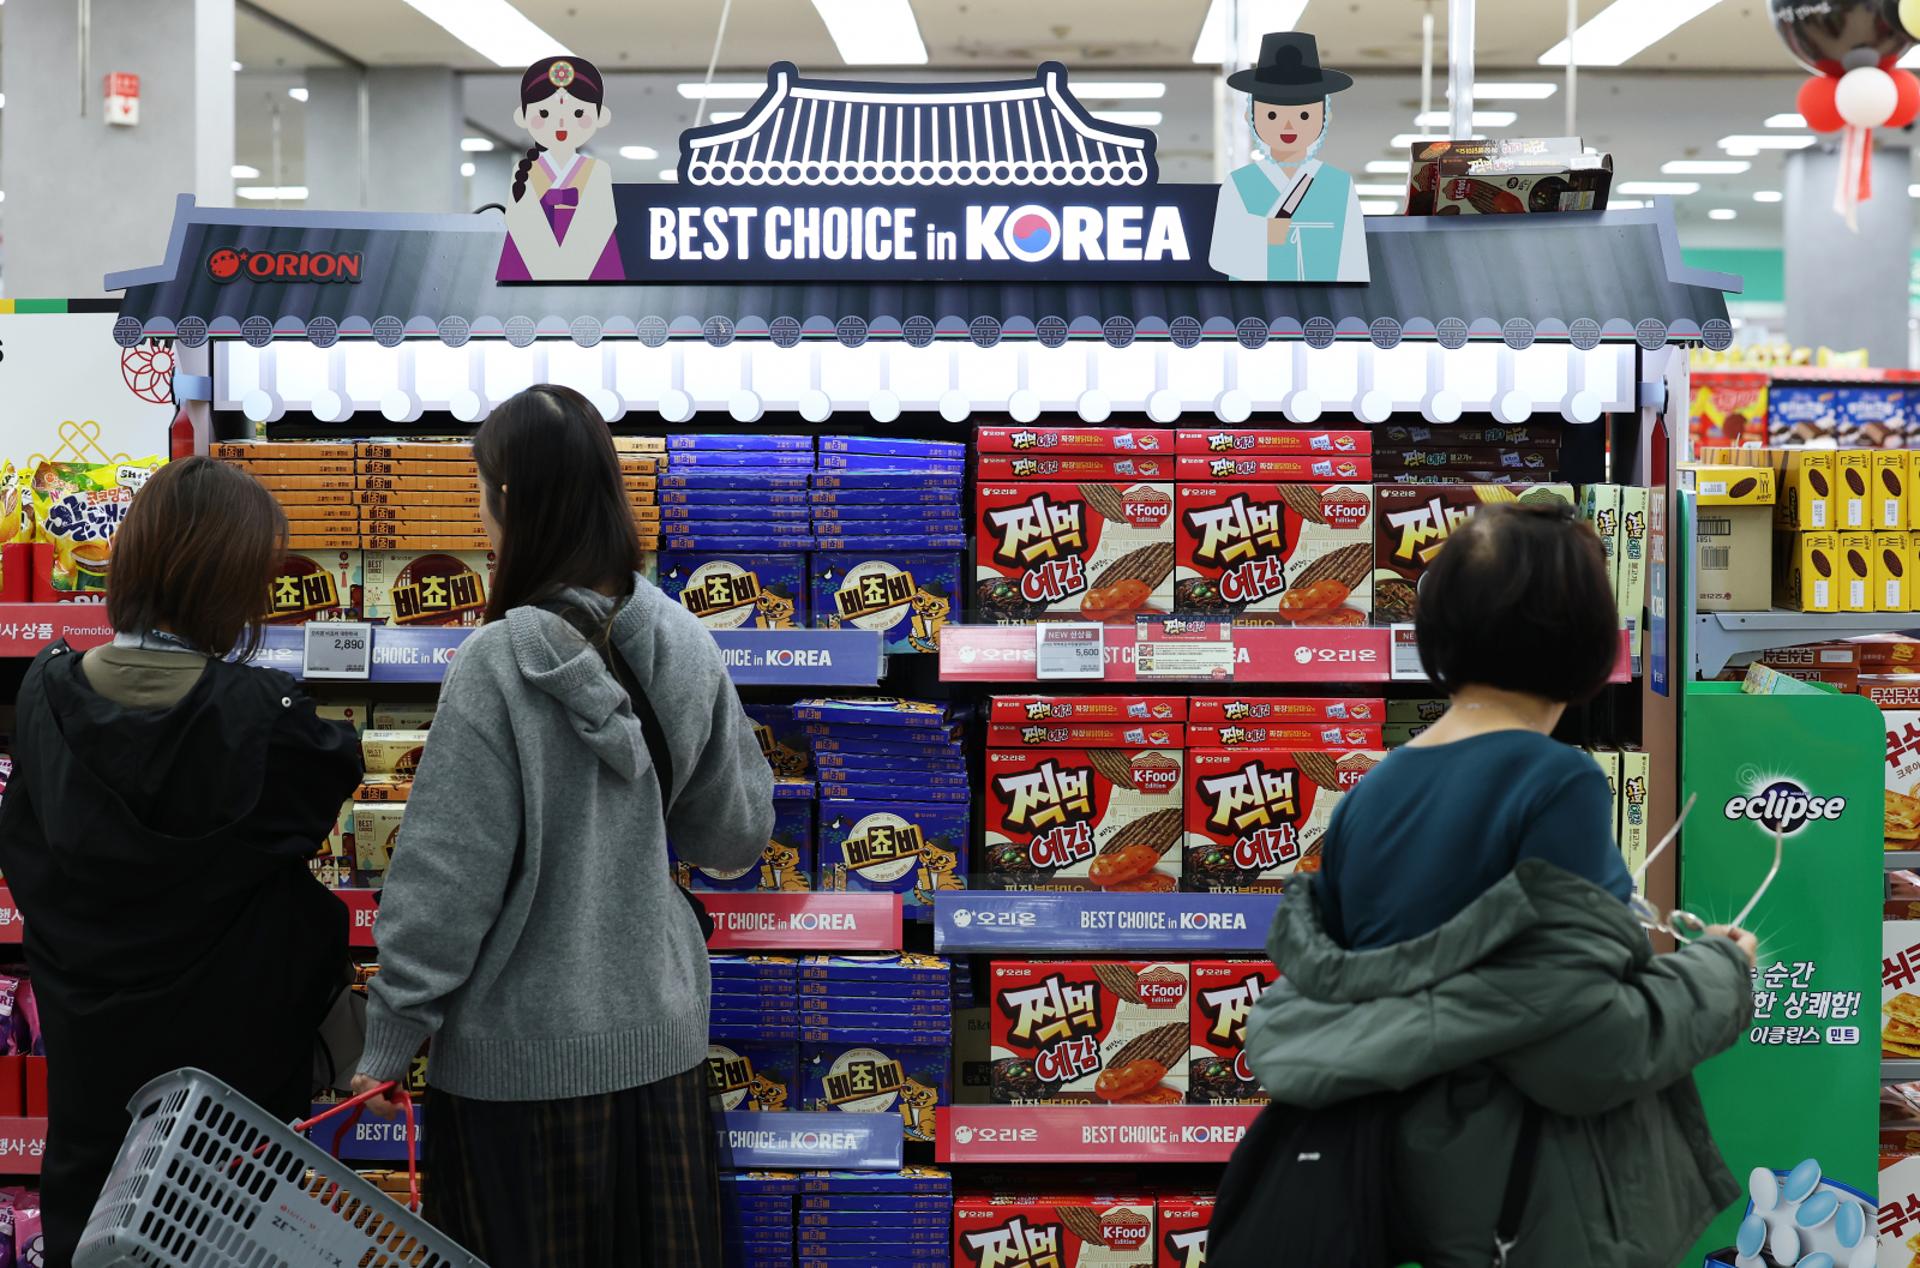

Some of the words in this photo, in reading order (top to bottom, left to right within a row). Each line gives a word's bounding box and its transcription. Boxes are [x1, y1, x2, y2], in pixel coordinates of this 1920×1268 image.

[649, 207, 756, 260] BEST
[764, 206, 917, 261] CHOICE
[927, 224, 956, 260] in
[965, 204, 1191, 263] KOREA
[248, 252, 361, 278] ORION
[1010, 430, 1037, 449] 찍먹
[1037, 433, 1058, 448] 예감
[1207, 432, 1234, 451] 찍먹
[1234, 435, 1255, 449] 예감
[1011, 457, 1038, 477] 찍먹
[1038, 460, 1059, 474] 예감
[1209, 458, 1236, 478] 찍먹
[1236, 460, 1256, 474] 예감
[1402, 450, 1427, 466] 찍먹
[989, 496, 1082, 562] 찍먹
[1188, 496, 1280, 562] 찍먹
[1597, 508, 1618, 537] 찍먹
[1625, 511, 1646, 539] 찍먹
[1626, 538, 1642, 560] 예감
[1021, 559, 1086, 603] 예감
[1219, 559, 1285, 603] 예감
[268, 574, 330, 615] 쵸비
[393, 574, 481, 618] 비쵸비
[684, 573, 757, 616] 비쵸비
[839, 573, 912, 615] 비쵸비
[0, 624, 18, 638] 사
[21, 624, 54, 640] 상품
[1048, 631, 1069, 639] NEW
[1163, 618, 1187, 634] 찍먹
[1187, 620, 1206, 632] 예감
[1403, 632, 1415, 640] NE
[334, 639, 364, 650] 2,890
[1075, 648, 1099, 656] 5,600
[372, 647, 418, 665] CHOICE
[420, 649, 430, 664] in
[721, 649, 752, 667] OICE
[754, 653, 763, 666] in
[766, 649, 832, 667] KOREA
[1317, 648, 1377, 662] 오리온
[1025, 701, 1050, 720] 찍먹
[1050, 704, 1073, 718] 예감
[1223, 700, 1250, 720] 찍먹
[1250, 704, 1272, 718] 예감
[1020, 725, 1048, 744] 찍먹
[1048, 727, 1069, 742] 예감
[1218, 725, 1246, 744] 찍먹
[1246, 728, 1266, 742] 예감
[361, 788, 388, 800] 비쵸비
[998, 762, 1091, 828] 찍먹
[1202, 764, 1296, 830] 찍먹
[1625, 775, 1646, 804] 찍먹
[1725, 790, 1846, 828] eclipse
[846, 827, 919, 865] 비쵸비
[1029, 820, 1095, 868] 예감
[1233, 822, 1301, 870] 예감
[728, 912, 776, 931] CHOICE
[778, 918, 788, 930] in
[790, 912, 857, 931] KOREA
[977, 912, 1037, 926] 오리온
[1081, 911, 1115, 930] BEST
[1118, 911, 1166, 930] CHOICE
[1168, 916, 1178, 929] in
[1180, 911, 1247, 930] KOREA
[1006, 968, 1032, 976] 오리온
[1206, 968, 1232, 976] 오리온
[1764, 962, 1816, 988] 순간
[1003, 976, 1097, 1042] 찍먹
[1784, 992, 1861, 1019] 상쾌함!
[1750, 1026, 1821, 1044] 이클립스
[1831, 1028, 1855, 1042] 민트
[1034, 1035, 1100, 1083] 예감
[829, 1062, 901, 1099] 비쵸비
[356, 1123, 392, 1142] BEST
[729, 1130, 776, 1148] CHOICE
[778, 1135, 788, 1149] in
[790, 1131, 858, 1150] KOREA
[978, 1128, 1039, 1142] 오리온
[1082, 1126, 1115, 1144] BEST
[1120, 1126, 1166, 1144] CHOICE
[1170, 1130, 1180, 1144] in
[1182, 1126, 1246, 1144] KOREA
[968, 1210, 994, 1218] 오리온
[1174, 1210, 1200, 1218] 오리온
